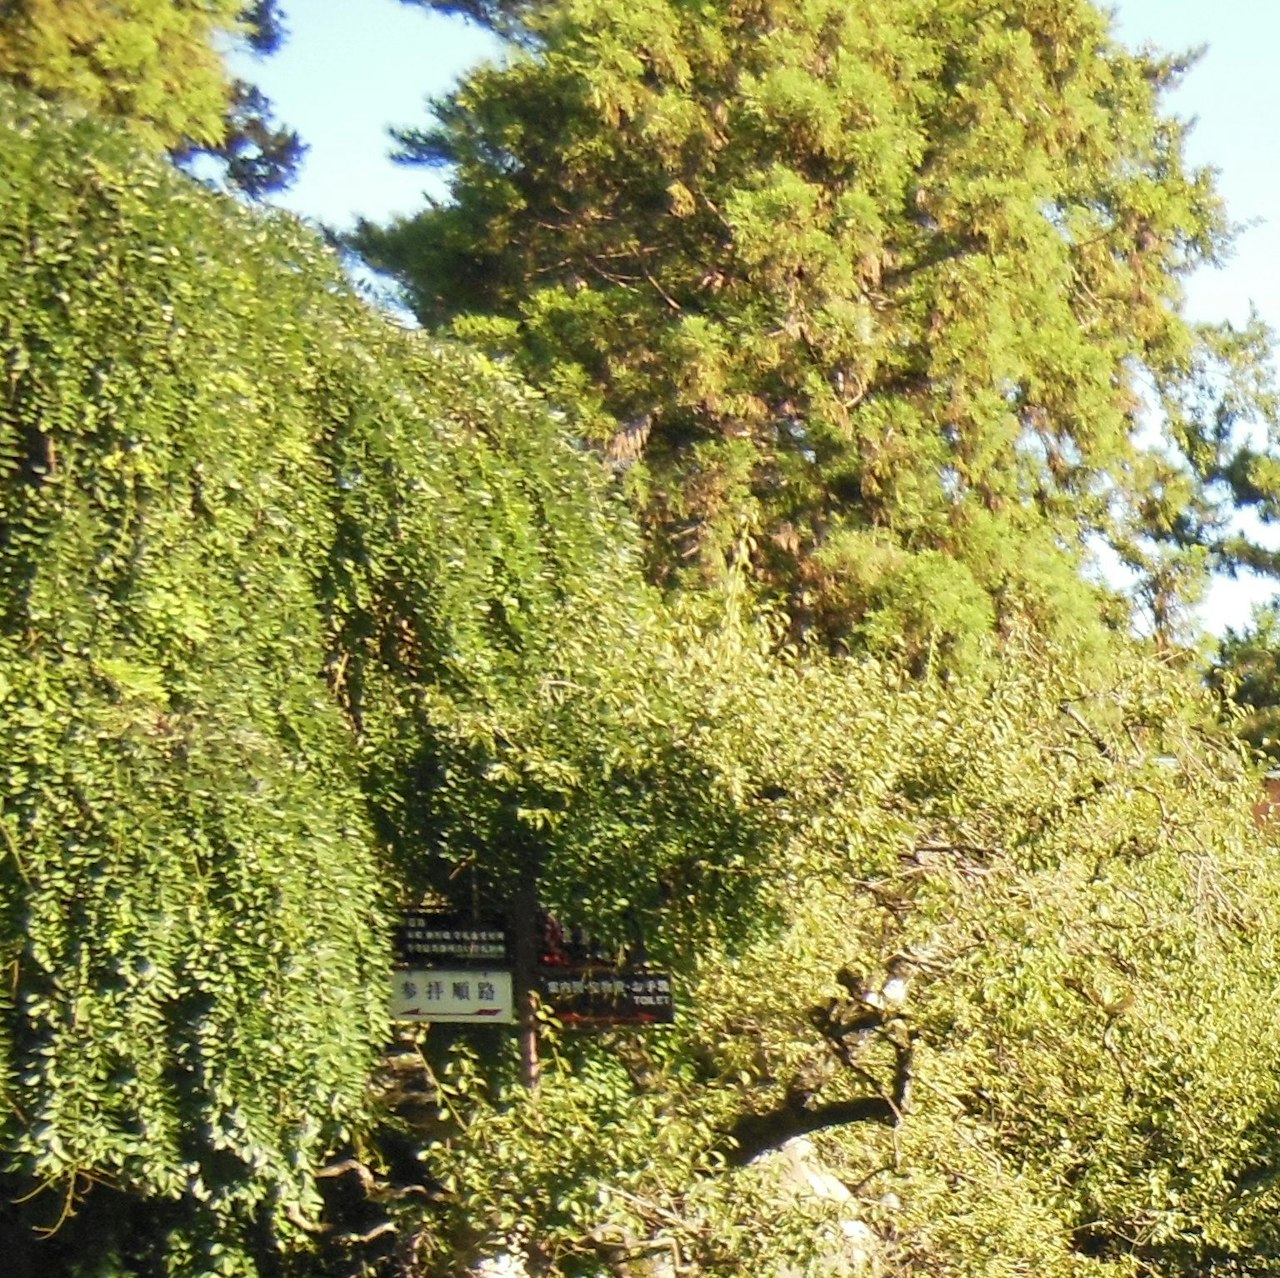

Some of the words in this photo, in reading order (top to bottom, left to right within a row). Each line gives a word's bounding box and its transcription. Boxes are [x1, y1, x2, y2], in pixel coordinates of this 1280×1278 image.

[401, 981, 495, 1000] 参拝順路
[633, 995, 670, 1005] TOILET
